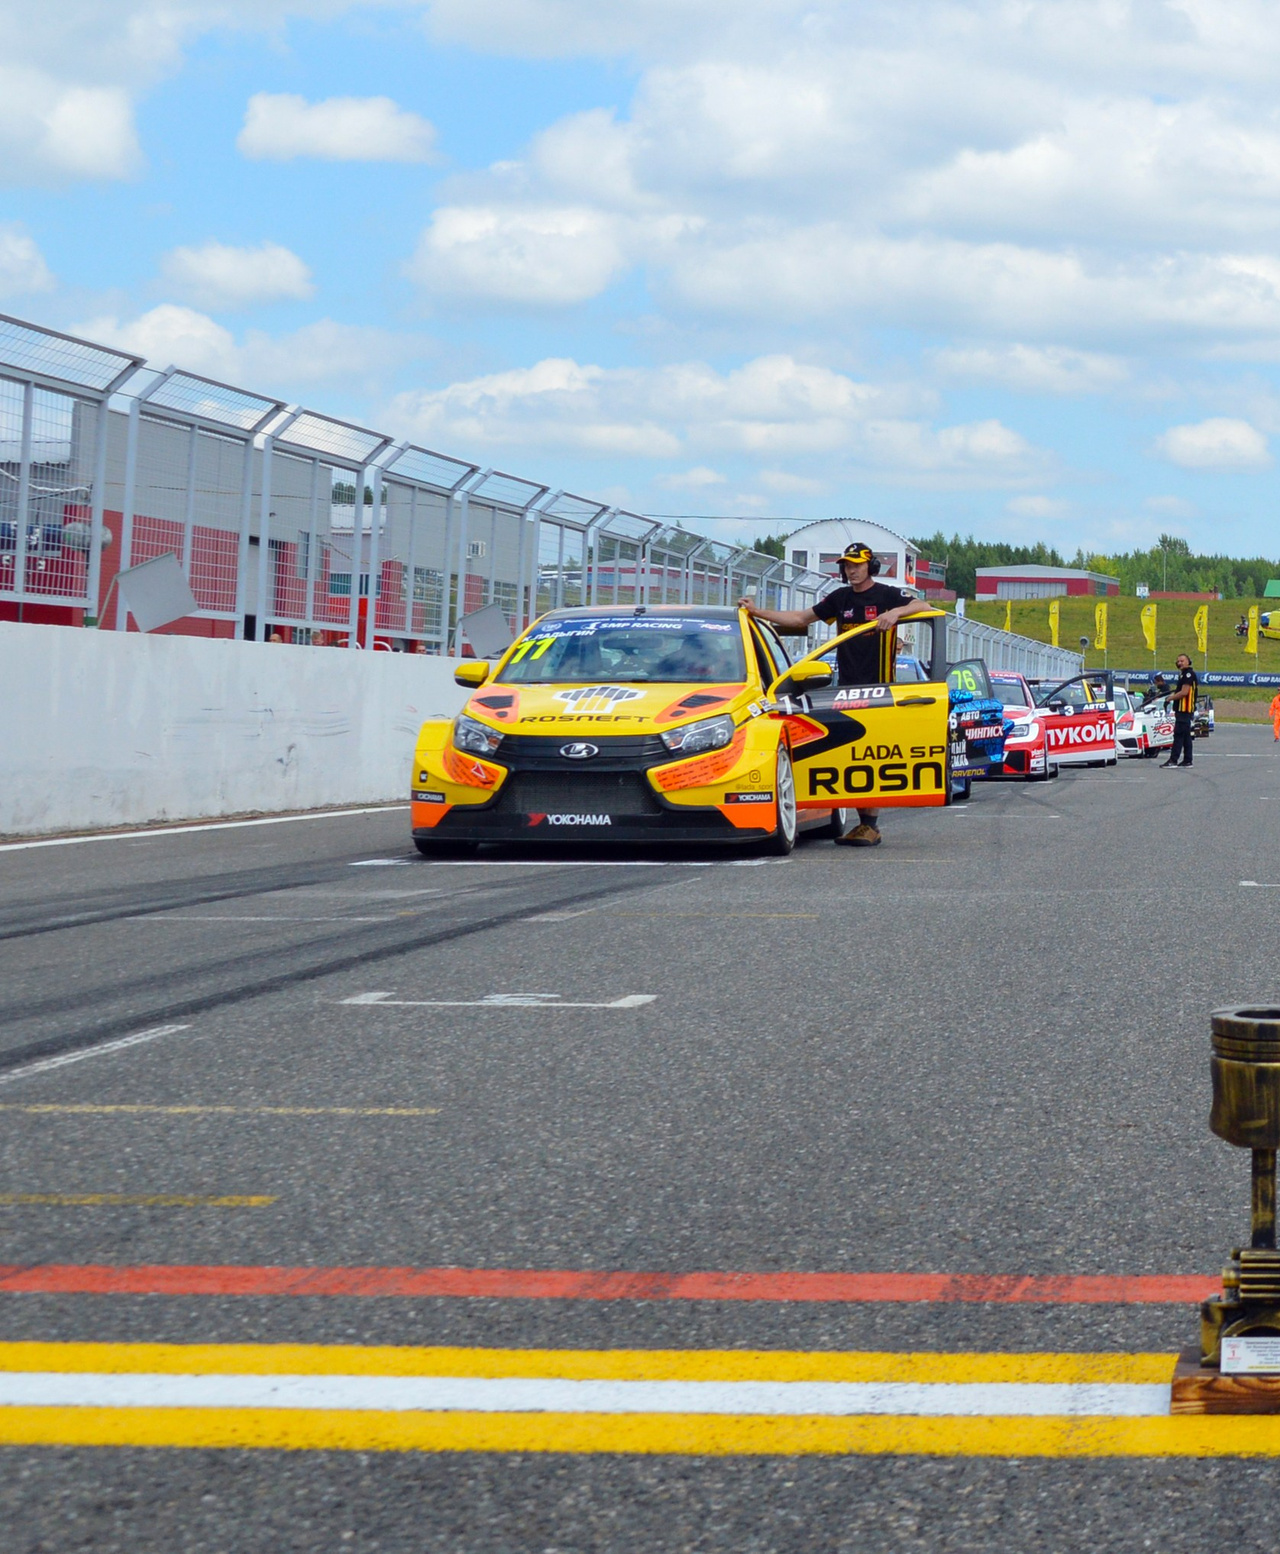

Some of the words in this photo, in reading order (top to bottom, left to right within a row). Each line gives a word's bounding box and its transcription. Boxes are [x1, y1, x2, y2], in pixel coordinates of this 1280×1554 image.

[631, 622, 683, 630] RACING
[531, 629, 596, 641] ЛАДЫГИН
[509, 637, 559, 665] 11
[951, 669, 977, 691] 76
[1222, 675, 1245, 683] RACING
[833, 687, 885, 701] АВТО
[779, 694, 811, 715] 11
[961, 710, 980, 721] АВТО
[1064, 705, 1075, 717] 3
[520, 715, 651, 724] ROSNEFT
[850, 744, 904, 761] LADA
[910, 745, 947, 759] SP
[808, 762, 944, 796] ROSN
[952, 768, 986, 779] RAVENOL
[738, 794, 772, 802] YOKOHAMA
[546, 813, 612, 826] YOKOHAMA
